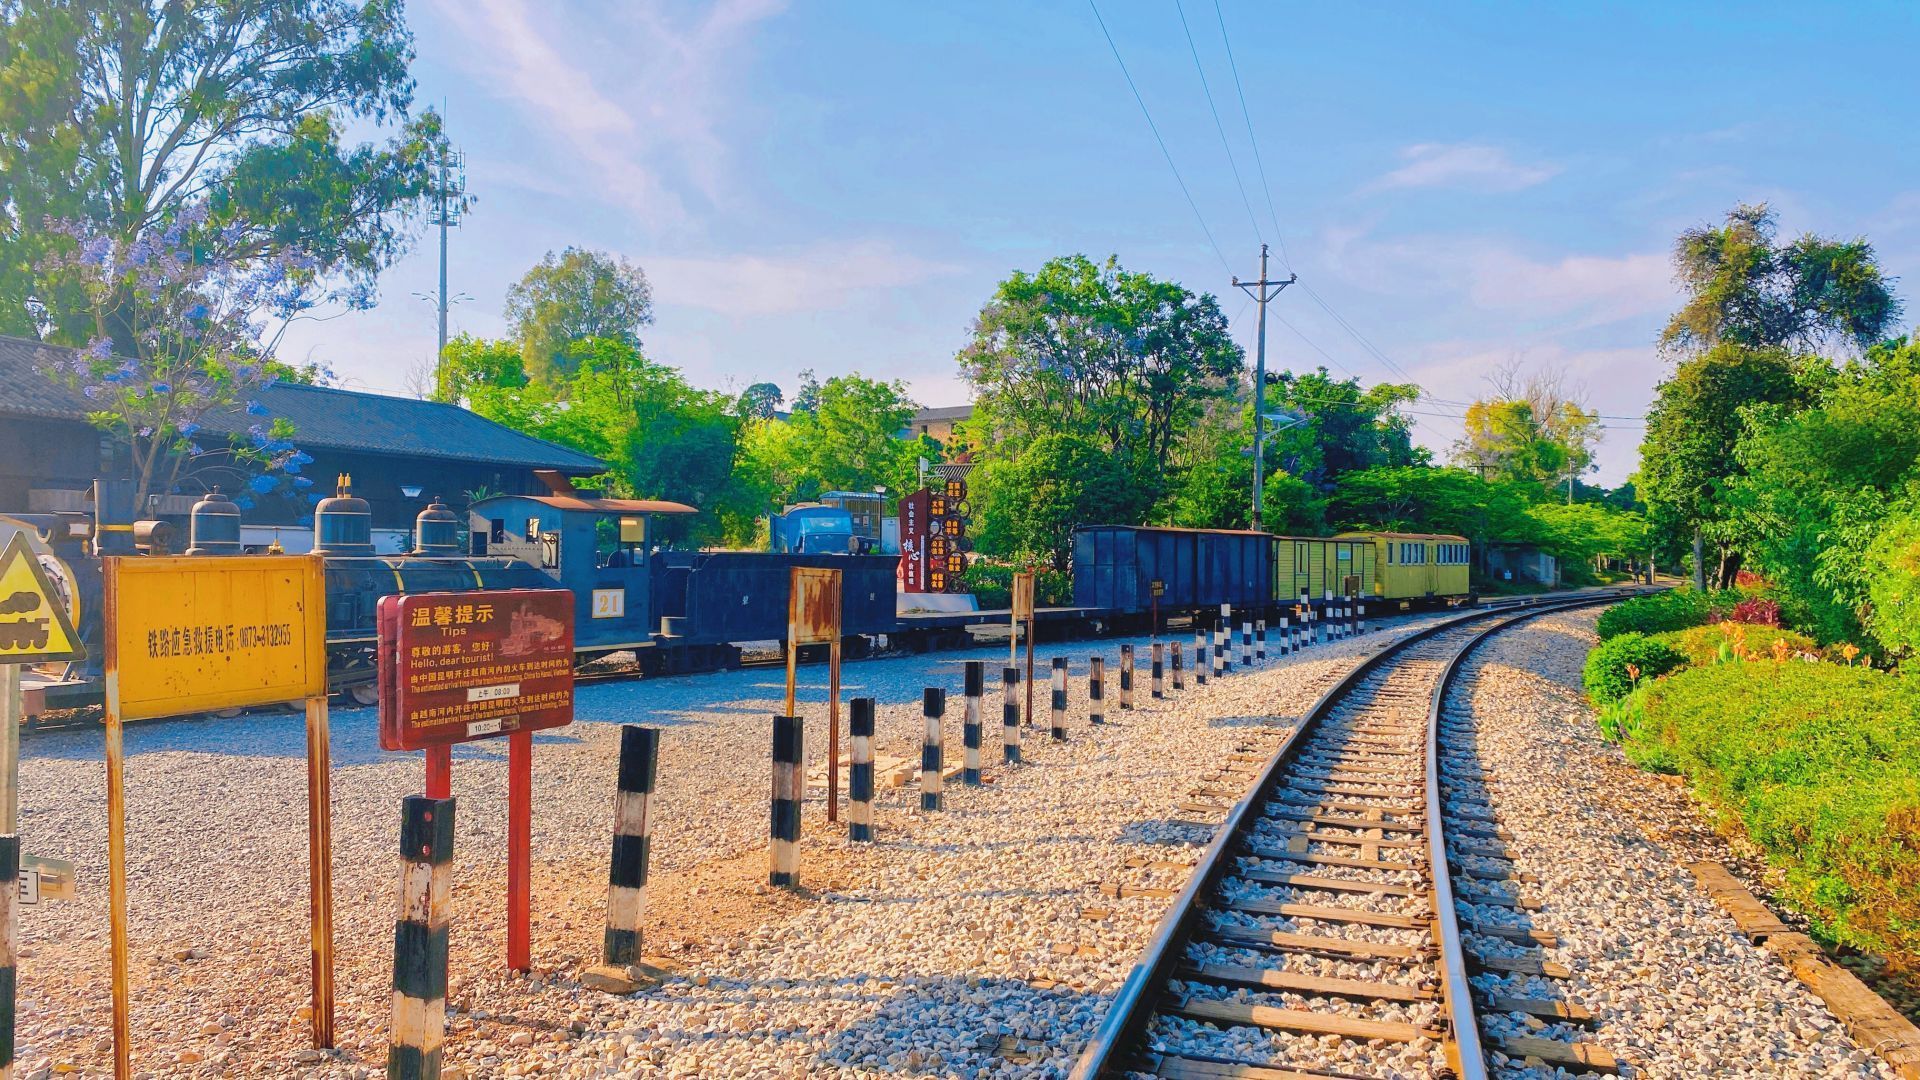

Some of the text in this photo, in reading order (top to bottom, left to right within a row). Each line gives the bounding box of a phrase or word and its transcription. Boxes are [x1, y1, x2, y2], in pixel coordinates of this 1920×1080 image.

[600, 595, 617, 612] 21
[411, 604, 494, 627] 温馨提示
[441, 627, 467, 637] Tips
[411, 653, 494, 669] Hello, dear tourist!
